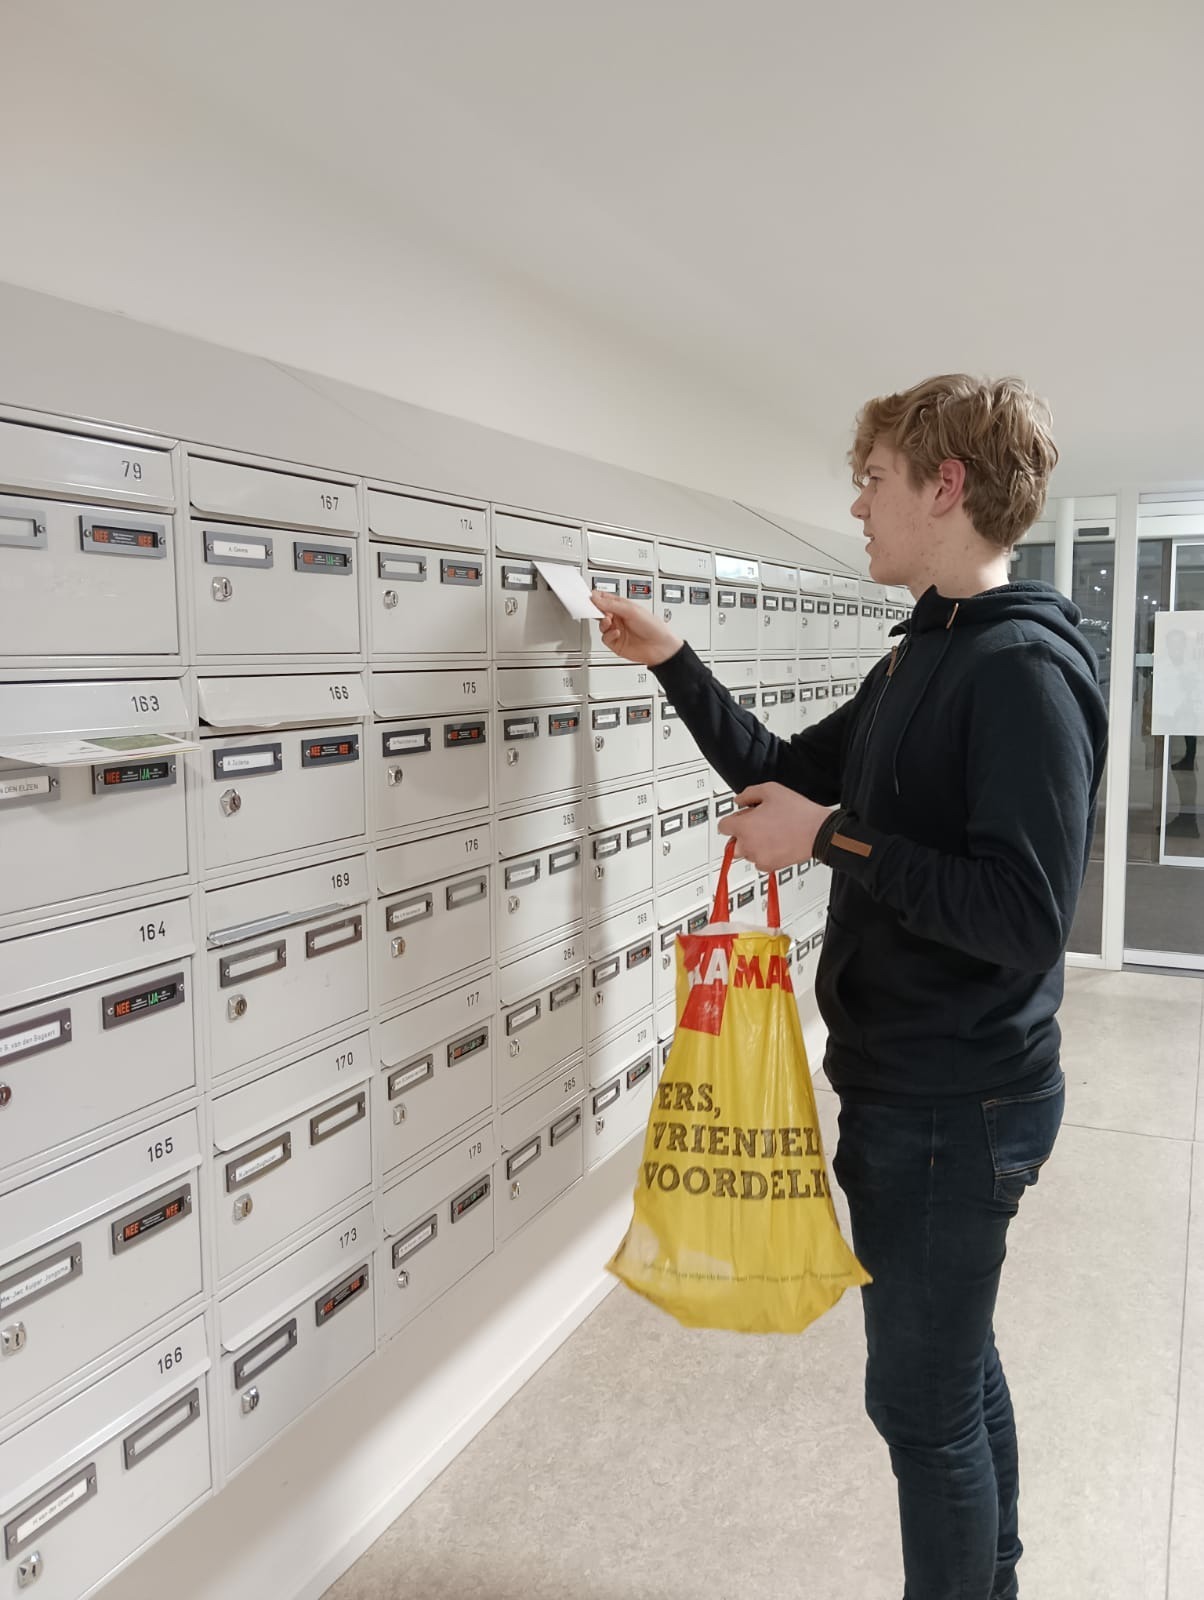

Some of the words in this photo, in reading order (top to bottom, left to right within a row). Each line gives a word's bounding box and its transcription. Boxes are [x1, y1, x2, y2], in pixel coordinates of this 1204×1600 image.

[122, 461, 142, 480] 79
[321, 495, 339, 511] 167
[463, 681, 477, 694] 175
[131, 696, 160, 714] 163
[106, 771, 120, 782] NEE
[563, 814, 575, 826] 263
[465, 839, 479, 852] 176
[331, 873, 349, 888] 169
[140, 921, 166, 942] 164
[116, 1001, 131, 1015] NEE
[150, 992, 158, 1004] JA
[467, 992, 480, 1007] 177
[336, 1052, 354, 1071] 170
[564, 1079, 576, 1092] 265
[658, 1081, 721, 1119] ERS,
[148, 1138, 174, 1162] 165
[469, 1142, 482, 1159] 178
[165, 1203, 178, 1218] NEE
[125, 1222, 139, 1238] NEE
[340, 1228, 357, 1249] 173
[158, 1347, 183, 1375] 166
